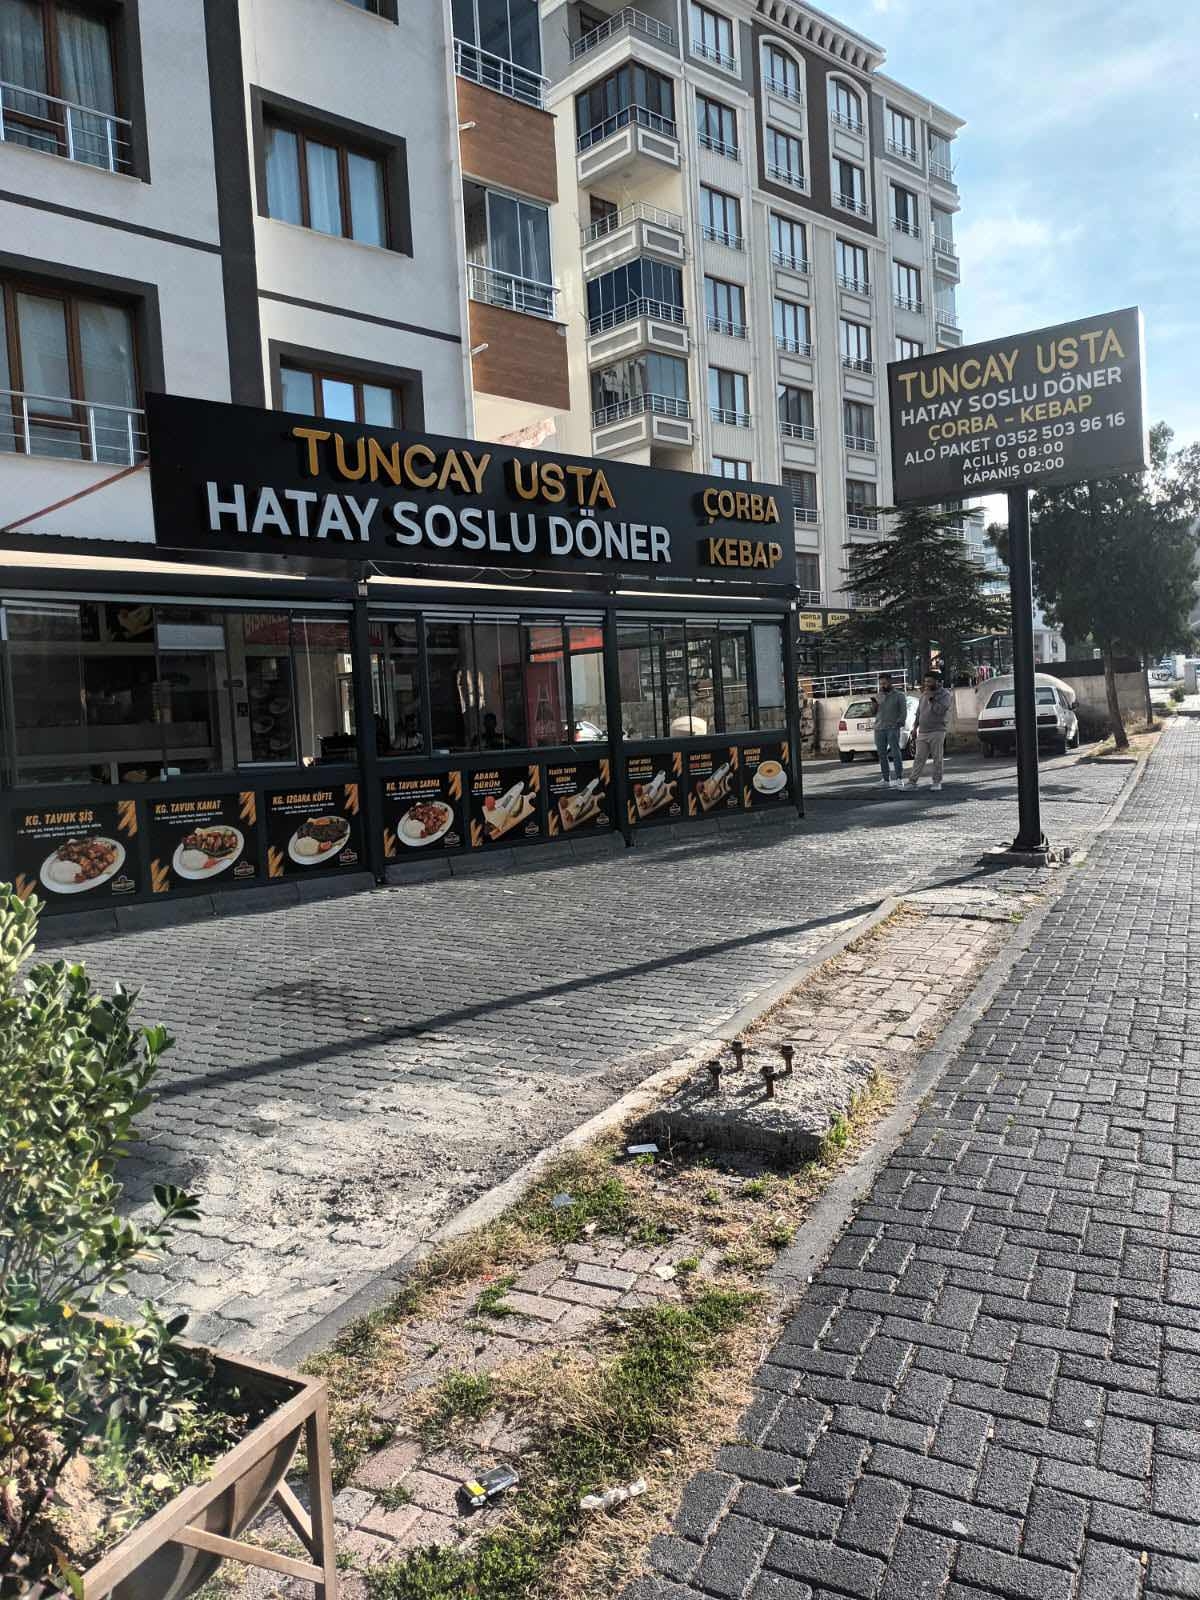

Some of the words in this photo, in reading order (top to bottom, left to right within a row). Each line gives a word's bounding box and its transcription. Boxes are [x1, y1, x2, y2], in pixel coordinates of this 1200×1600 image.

[898, 348, 1019, 403] TUNCAY
[1036, 327, 1126, 374] USTA
[900, 398, 963, 427] HATAY
[968, 383, 1037, 413] SOSLU
[1044, 365, 1122, 398] DÖNER
[904, 447, 936, 466] ALO
[940, 437, 992, 459] PAKET
[995, 428, 1038, 448] 0352
[1042, 421, 1075, 440] 503
[1080, 416, 1102, 433] 96
[1106, 411, 1126, 429] 16
[928, 413, 998, 445] ÇORBA
[1020, 394, 1093, 424] KEBAP
[292, 426, 492, 495] TUNCAY
[513, 457, 617, 509] USTA
[962, 451, 1009, 471] AÇILIŞ
[1017, 441, 1064, 460] 08:00
[963, 466, 1020, 486] KAPANIŞ
[1023, 456, 1065, 475] 02:00
[206, 480, 380, 542] HATAY
[392, 501, 537, 554] SOSLU
[548, 507, 672, 564] DÖNER
[703, 487, 780, 524] ÇORBA
[709, 537, 783, 568] KEBAP
[44, 811, 76, 825] TAVUK
[171, 802, 195, 813] TAVUK
[197, 800, 222, 811] KANAT
